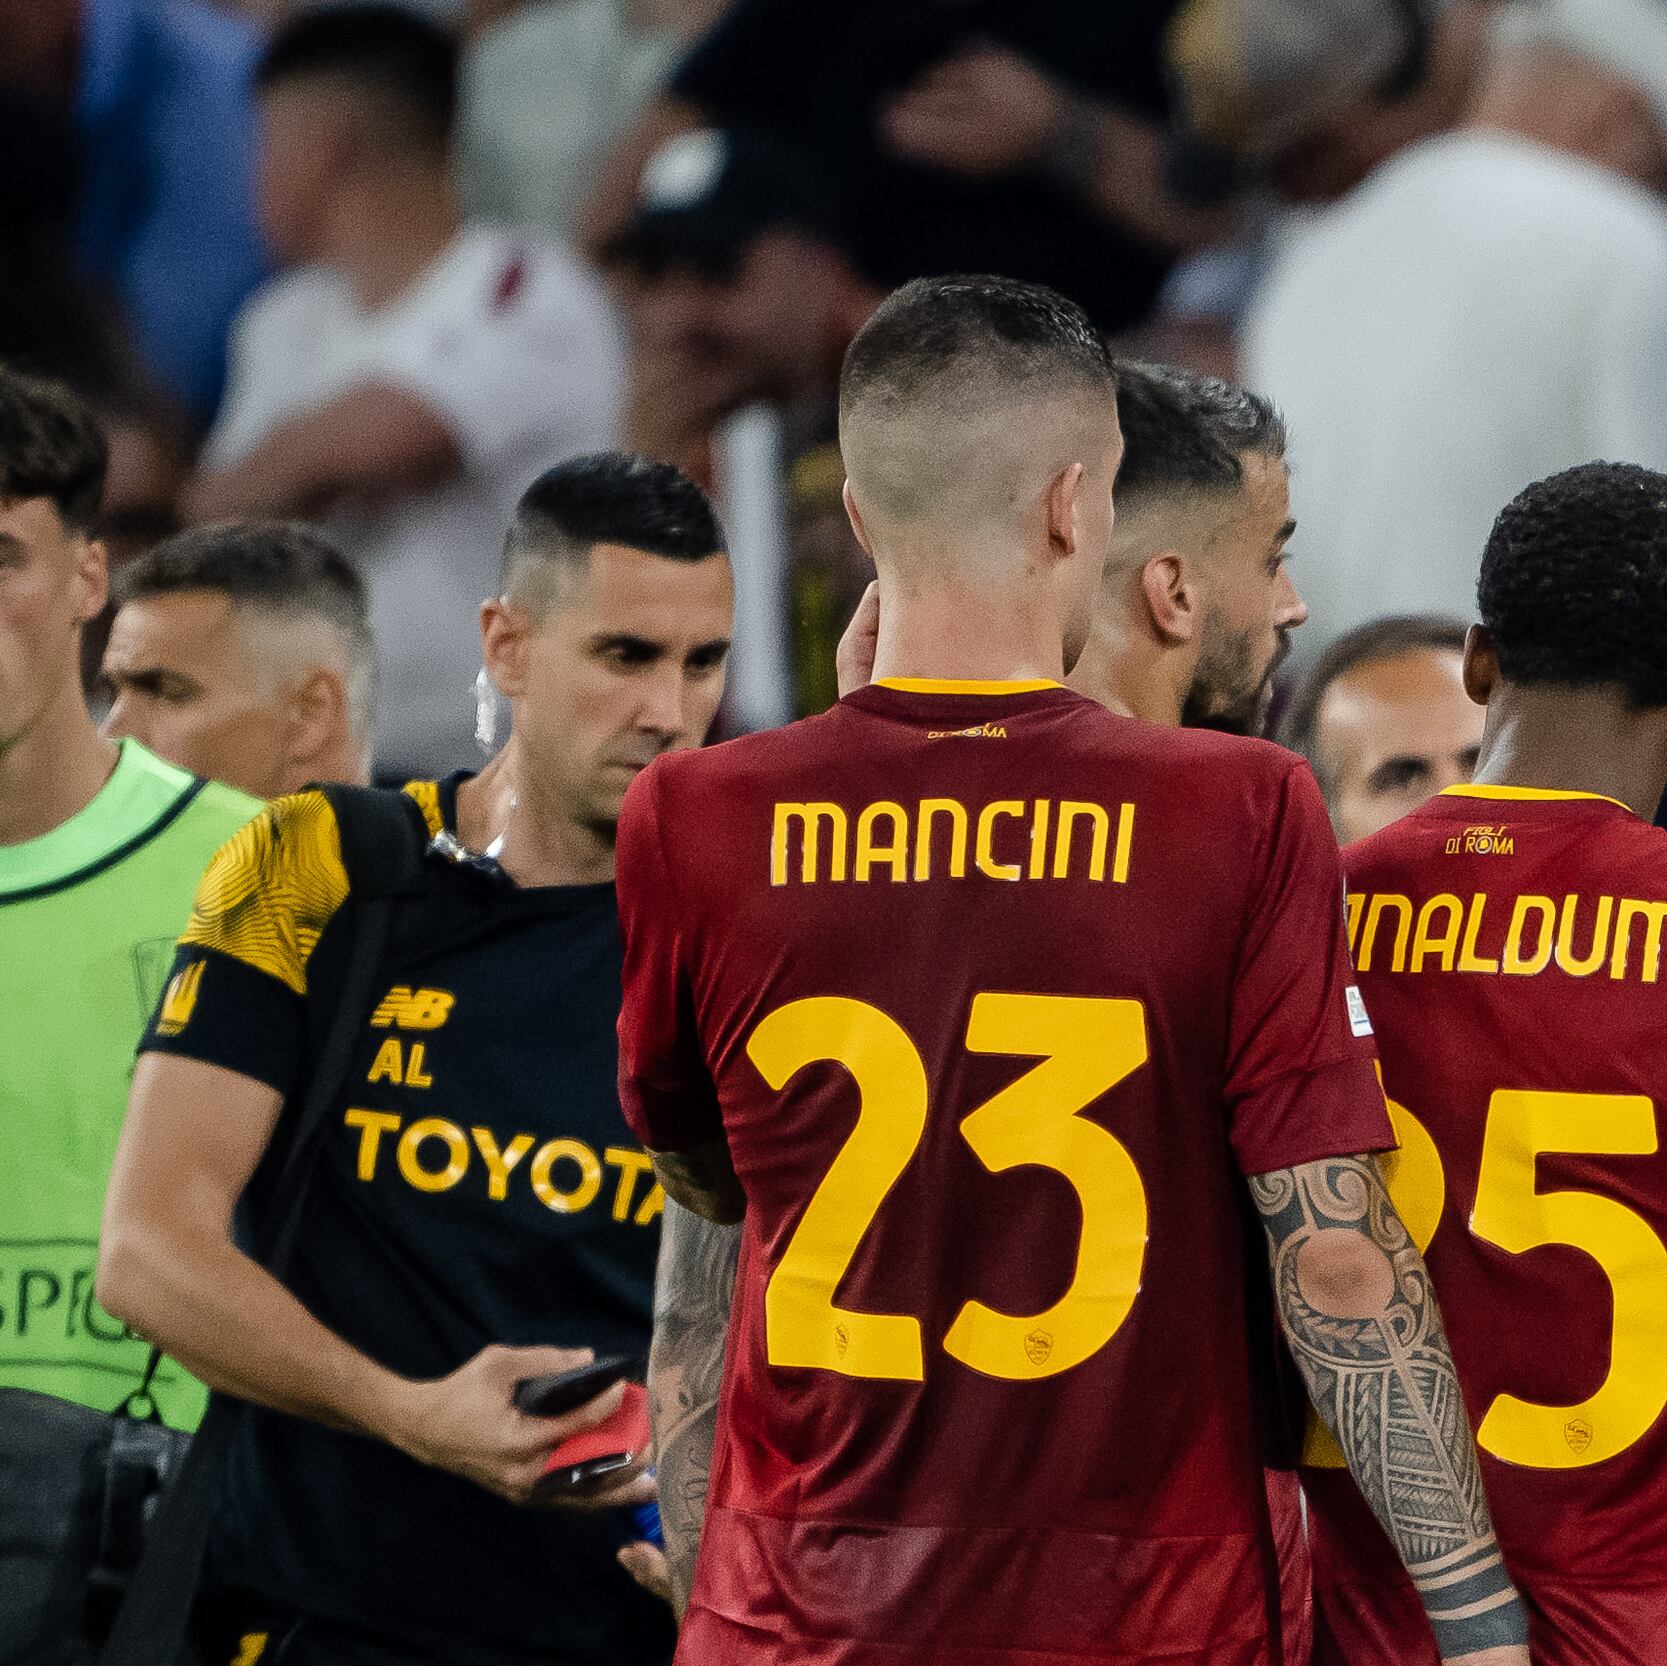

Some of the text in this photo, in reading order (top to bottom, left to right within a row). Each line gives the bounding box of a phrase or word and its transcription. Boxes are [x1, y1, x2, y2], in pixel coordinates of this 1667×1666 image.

[770, 797, 1135, 886] MANCINI
[1445, 836, 1514, 855] DI ROMA
[367, 1037, 433, 1089] AL
[745, 992, 1149, 1382] 23
